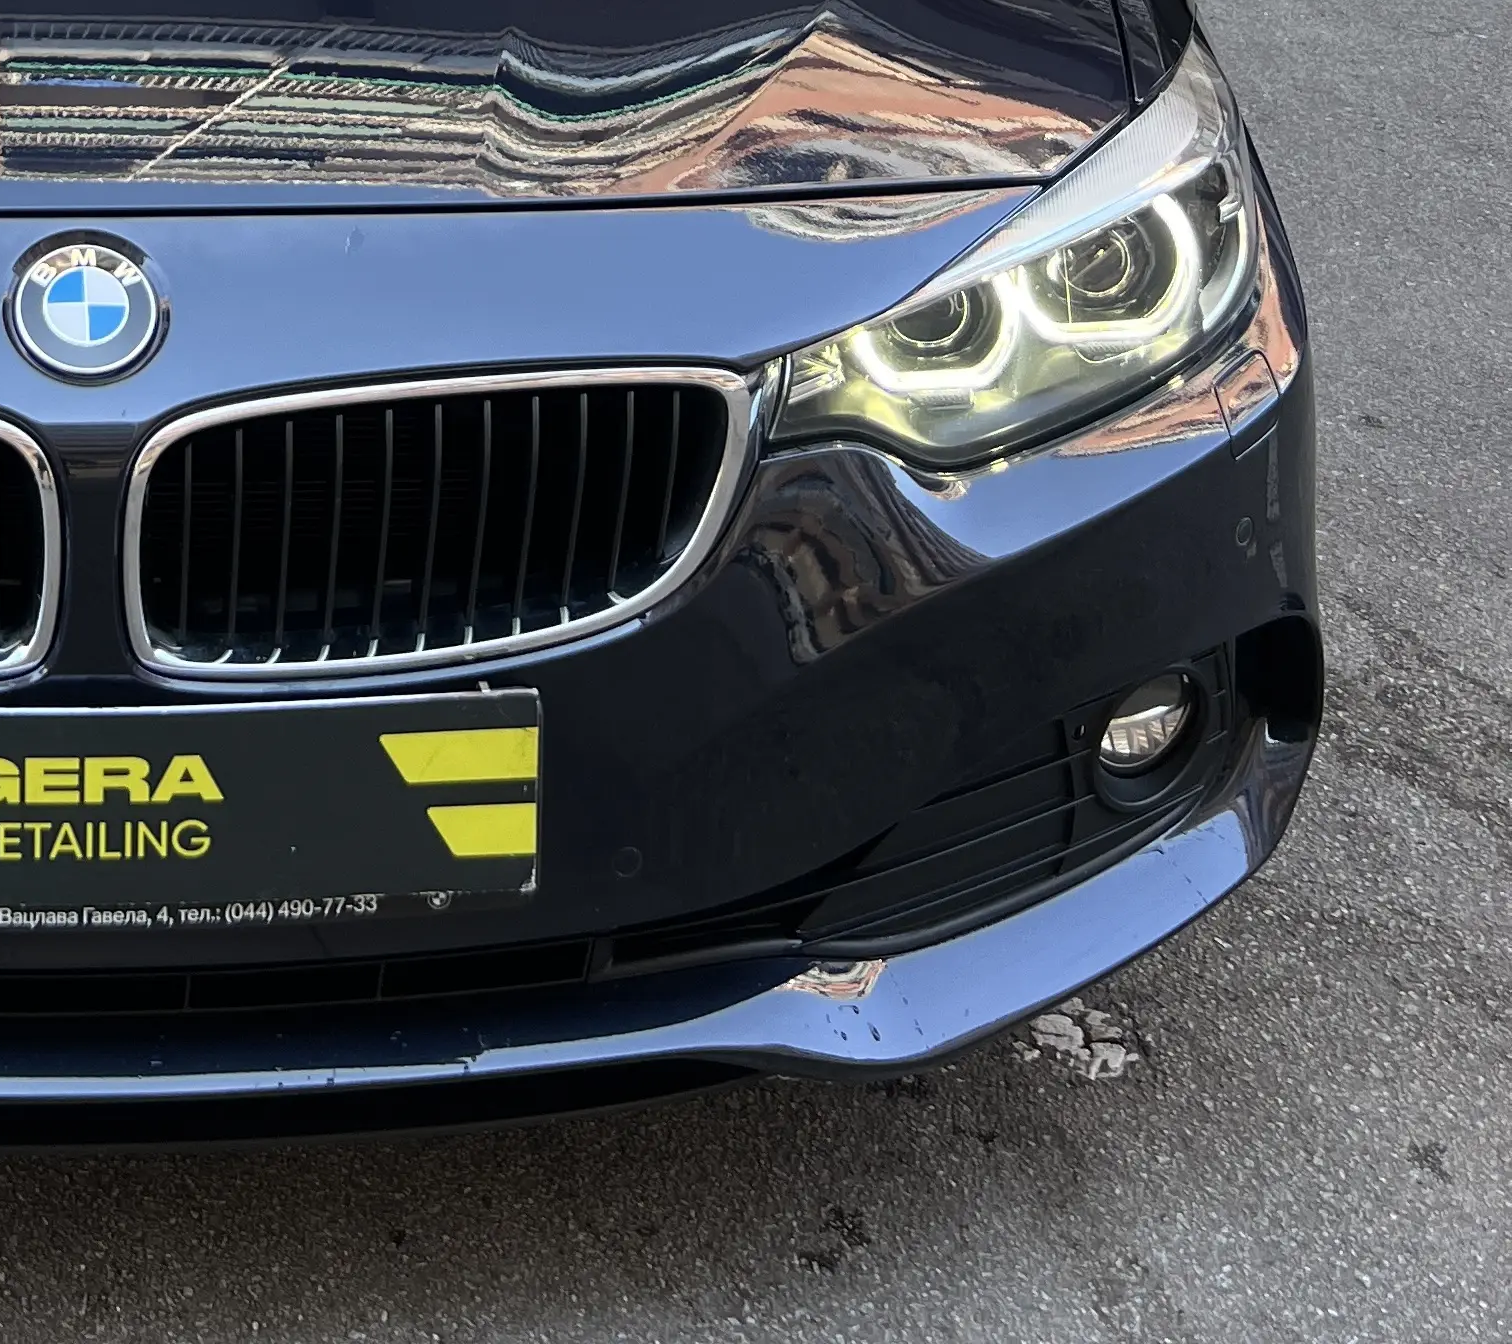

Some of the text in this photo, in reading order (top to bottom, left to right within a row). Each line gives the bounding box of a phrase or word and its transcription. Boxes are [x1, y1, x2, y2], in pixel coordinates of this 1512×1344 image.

[30, 248, 141, 288] BMW
[83, 906, 153, 930] Гавела,
[156, 906, 175, 929] 4,
[224, 901, 274, 925] (044)
[278, 894, 378, 919] 490-77-33
